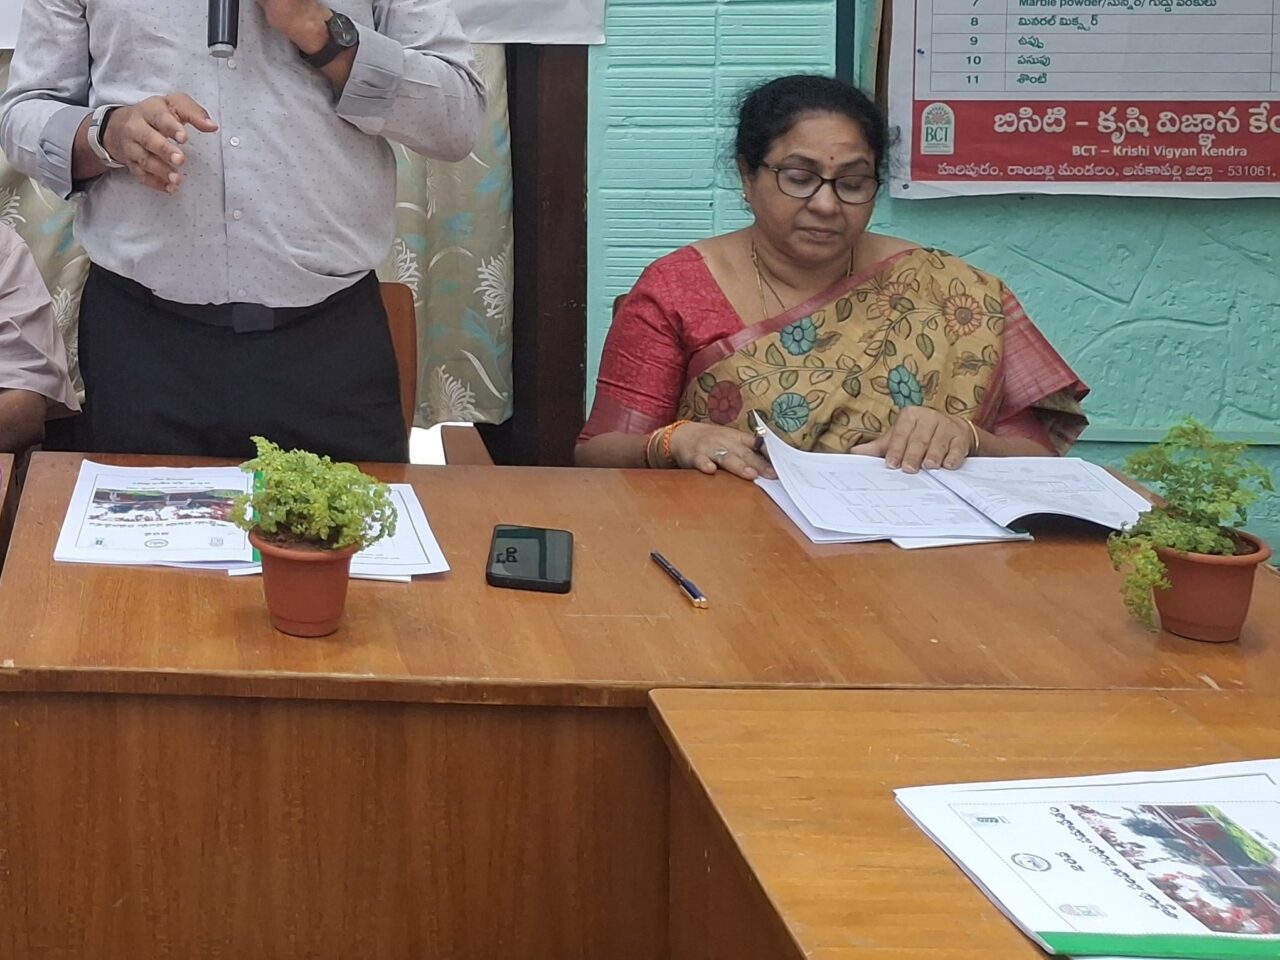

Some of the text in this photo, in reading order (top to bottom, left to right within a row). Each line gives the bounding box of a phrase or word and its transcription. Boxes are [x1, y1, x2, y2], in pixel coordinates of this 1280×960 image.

[970, 17, 979, 26] 8
[969, 36, 978, 45] 9
[966, 55, 982, 65] 10
[966, 74, 980, 84] 11
[993, 106, 1240, 146] బిసిటి కృషి విజ్ఞాన
[925, 126, 949, 142] BCT
[1072, 145, 1248, 158] BCT Krishi Vigyan Kendra
